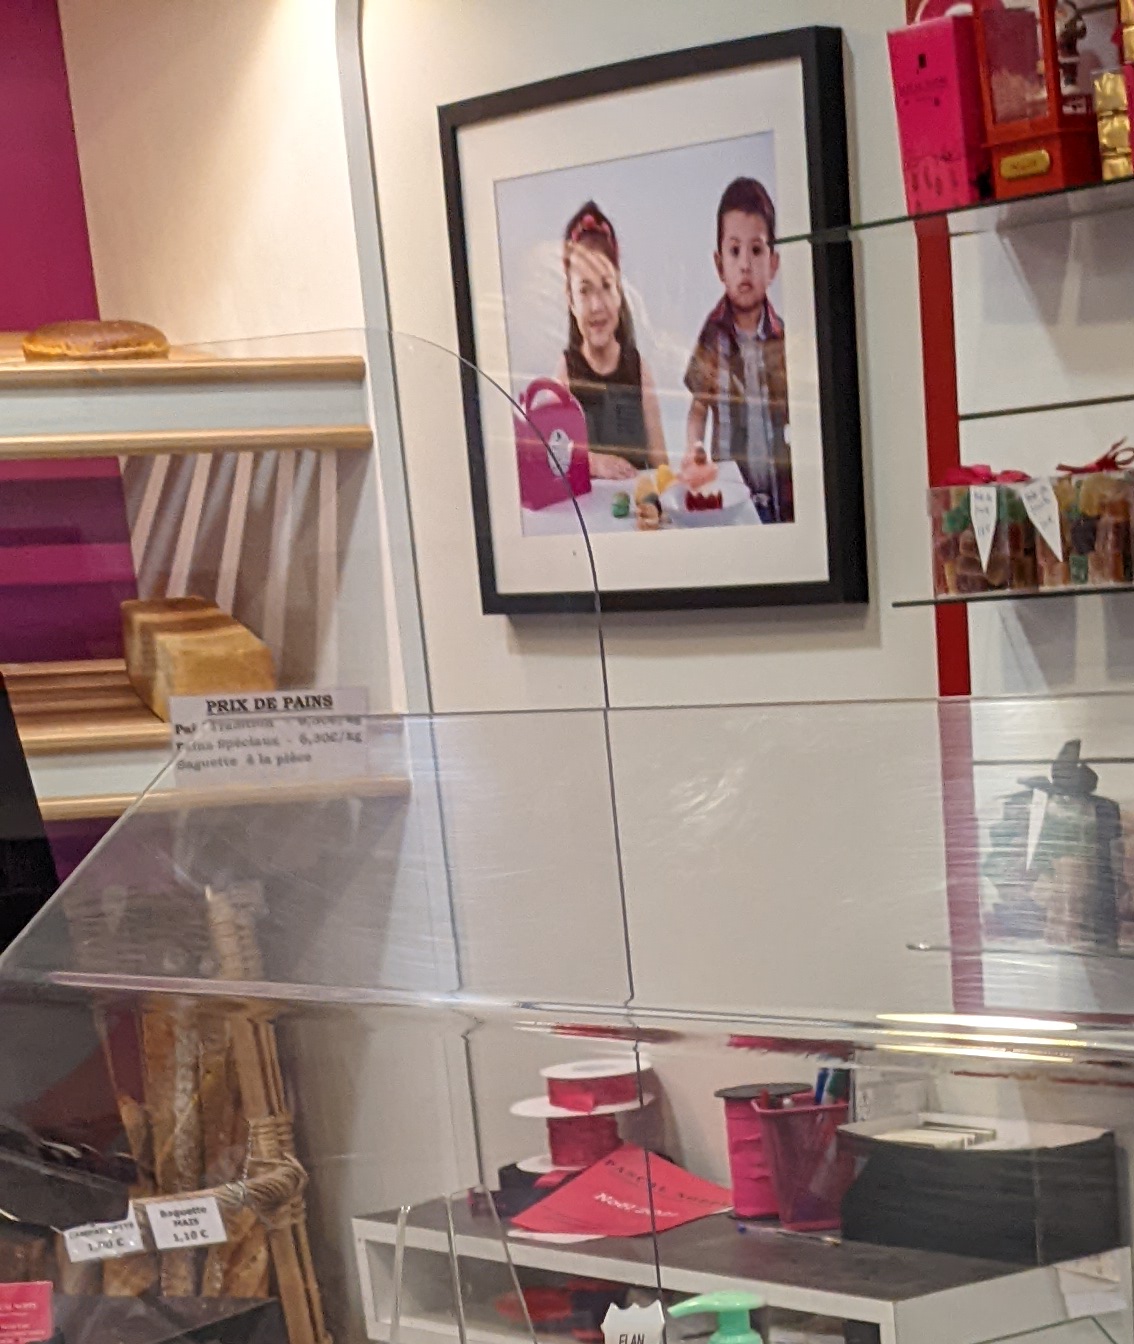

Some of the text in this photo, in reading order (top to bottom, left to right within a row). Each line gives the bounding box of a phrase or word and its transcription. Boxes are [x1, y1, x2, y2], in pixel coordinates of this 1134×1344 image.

[206, 694, 333, 715] PRIX DE PAINS
